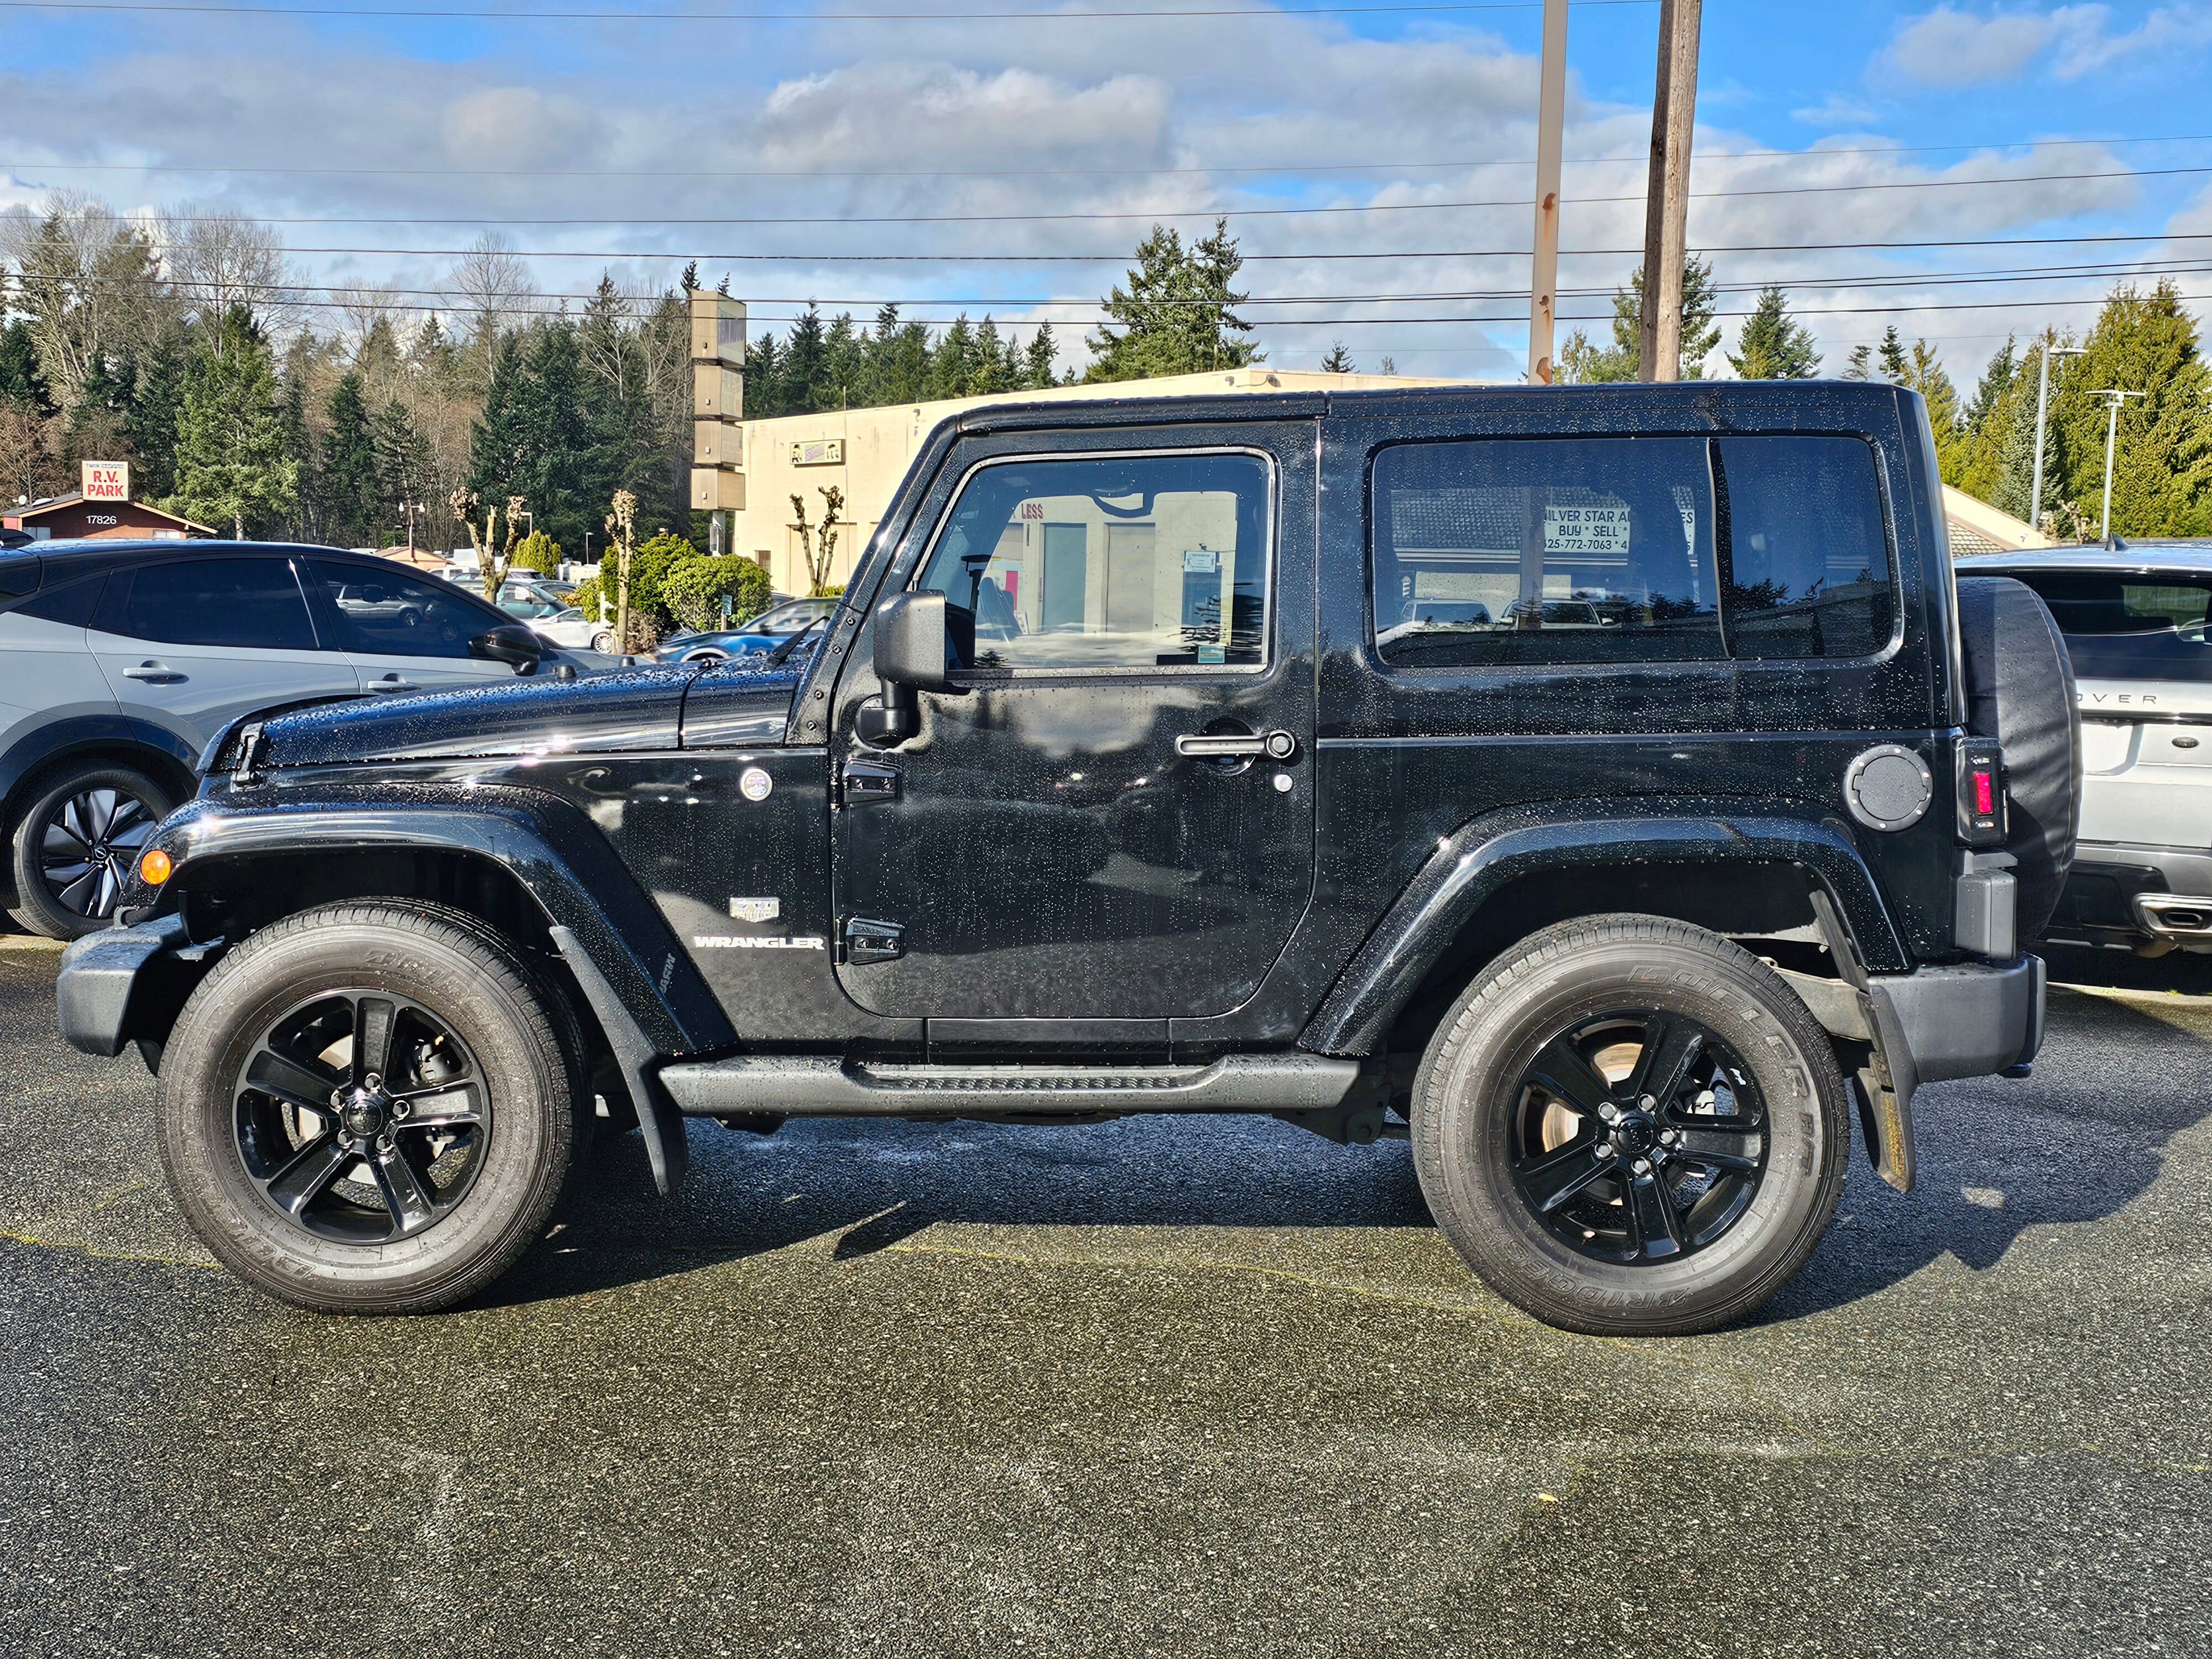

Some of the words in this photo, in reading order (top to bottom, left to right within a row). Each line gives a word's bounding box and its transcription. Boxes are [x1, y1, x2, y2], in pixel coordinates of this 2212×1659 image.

[93, 471, 118, 483] R.V.
[88, 484, 123, 497] PARK
[1021, 503, 1043, 519] LESS
[1545, 510, 1580, 521] ILVER
[1584, 510, 1614, 522] STAR
[86, 515, 117, 525] 17826
[1593, 526, 1619, 537] SELL
[1545, 539, 1611, 549] 25-772-7063
[694, 936, 825, 950] WRANGLER
